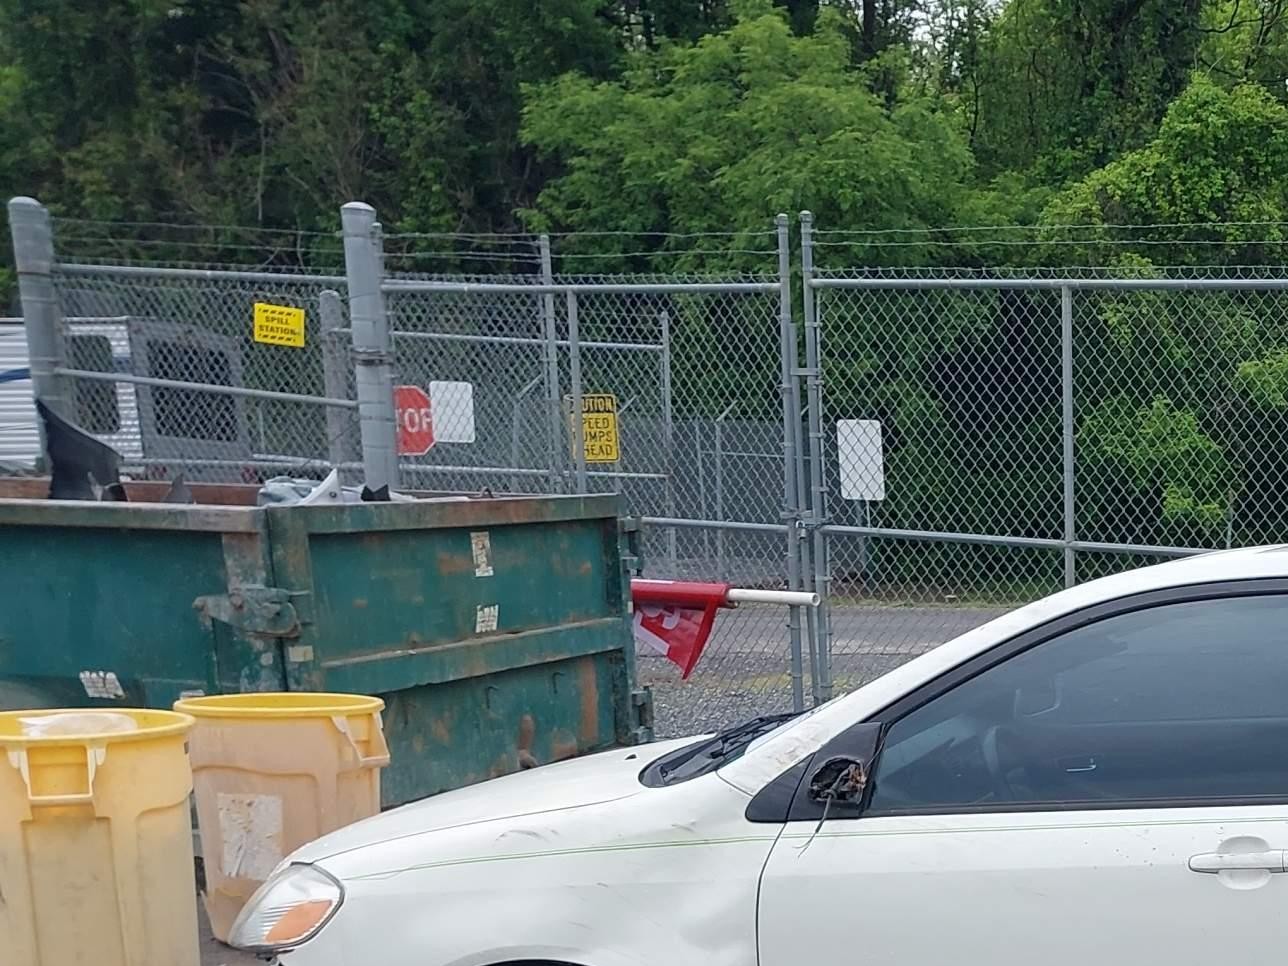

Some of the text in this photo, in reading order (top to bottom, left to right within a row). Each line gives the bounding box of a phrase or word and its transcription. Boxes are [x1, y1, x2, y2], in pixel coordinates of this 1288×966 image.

[265, 315, 290, 325] SPILL
[258, 325, 297, 336] STATION
[582, 396, 614, 411] UTION
[394, 407, 432, 433] TOP
[582, 417, 610, 429] PEED
[584, 430, 613, 442] UMPS
[583, 444, 613, 456] HEAD
